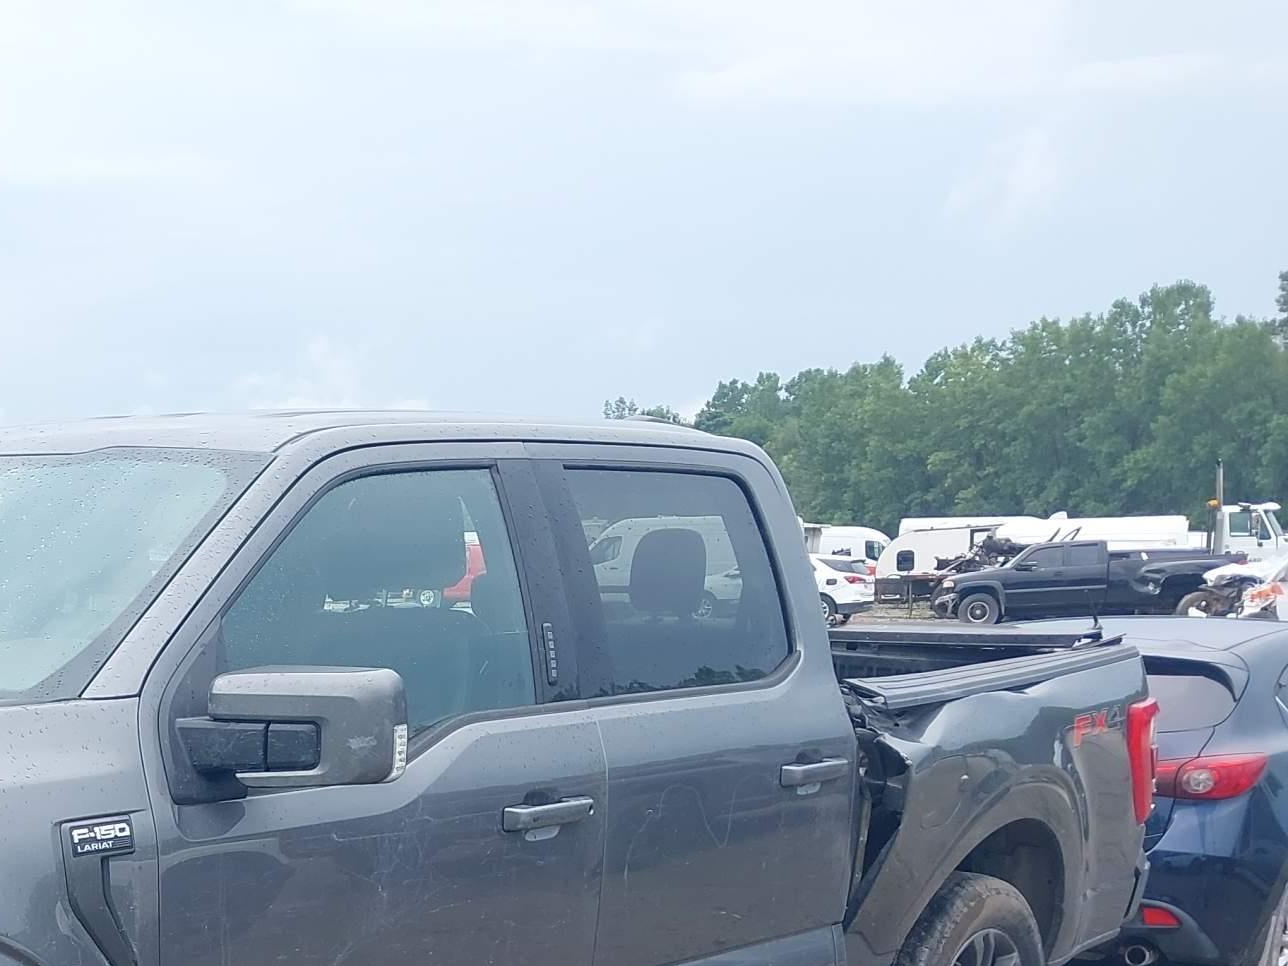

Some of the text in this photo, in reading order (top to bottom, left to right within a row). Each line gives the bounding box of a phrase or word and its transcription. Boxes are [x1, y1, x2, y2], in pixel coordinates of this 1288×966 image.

[1072, 704, 1126, 751] FX4
[72, 823, 131, 844] F-150
[77, 840, 115, 853] LARIAT
